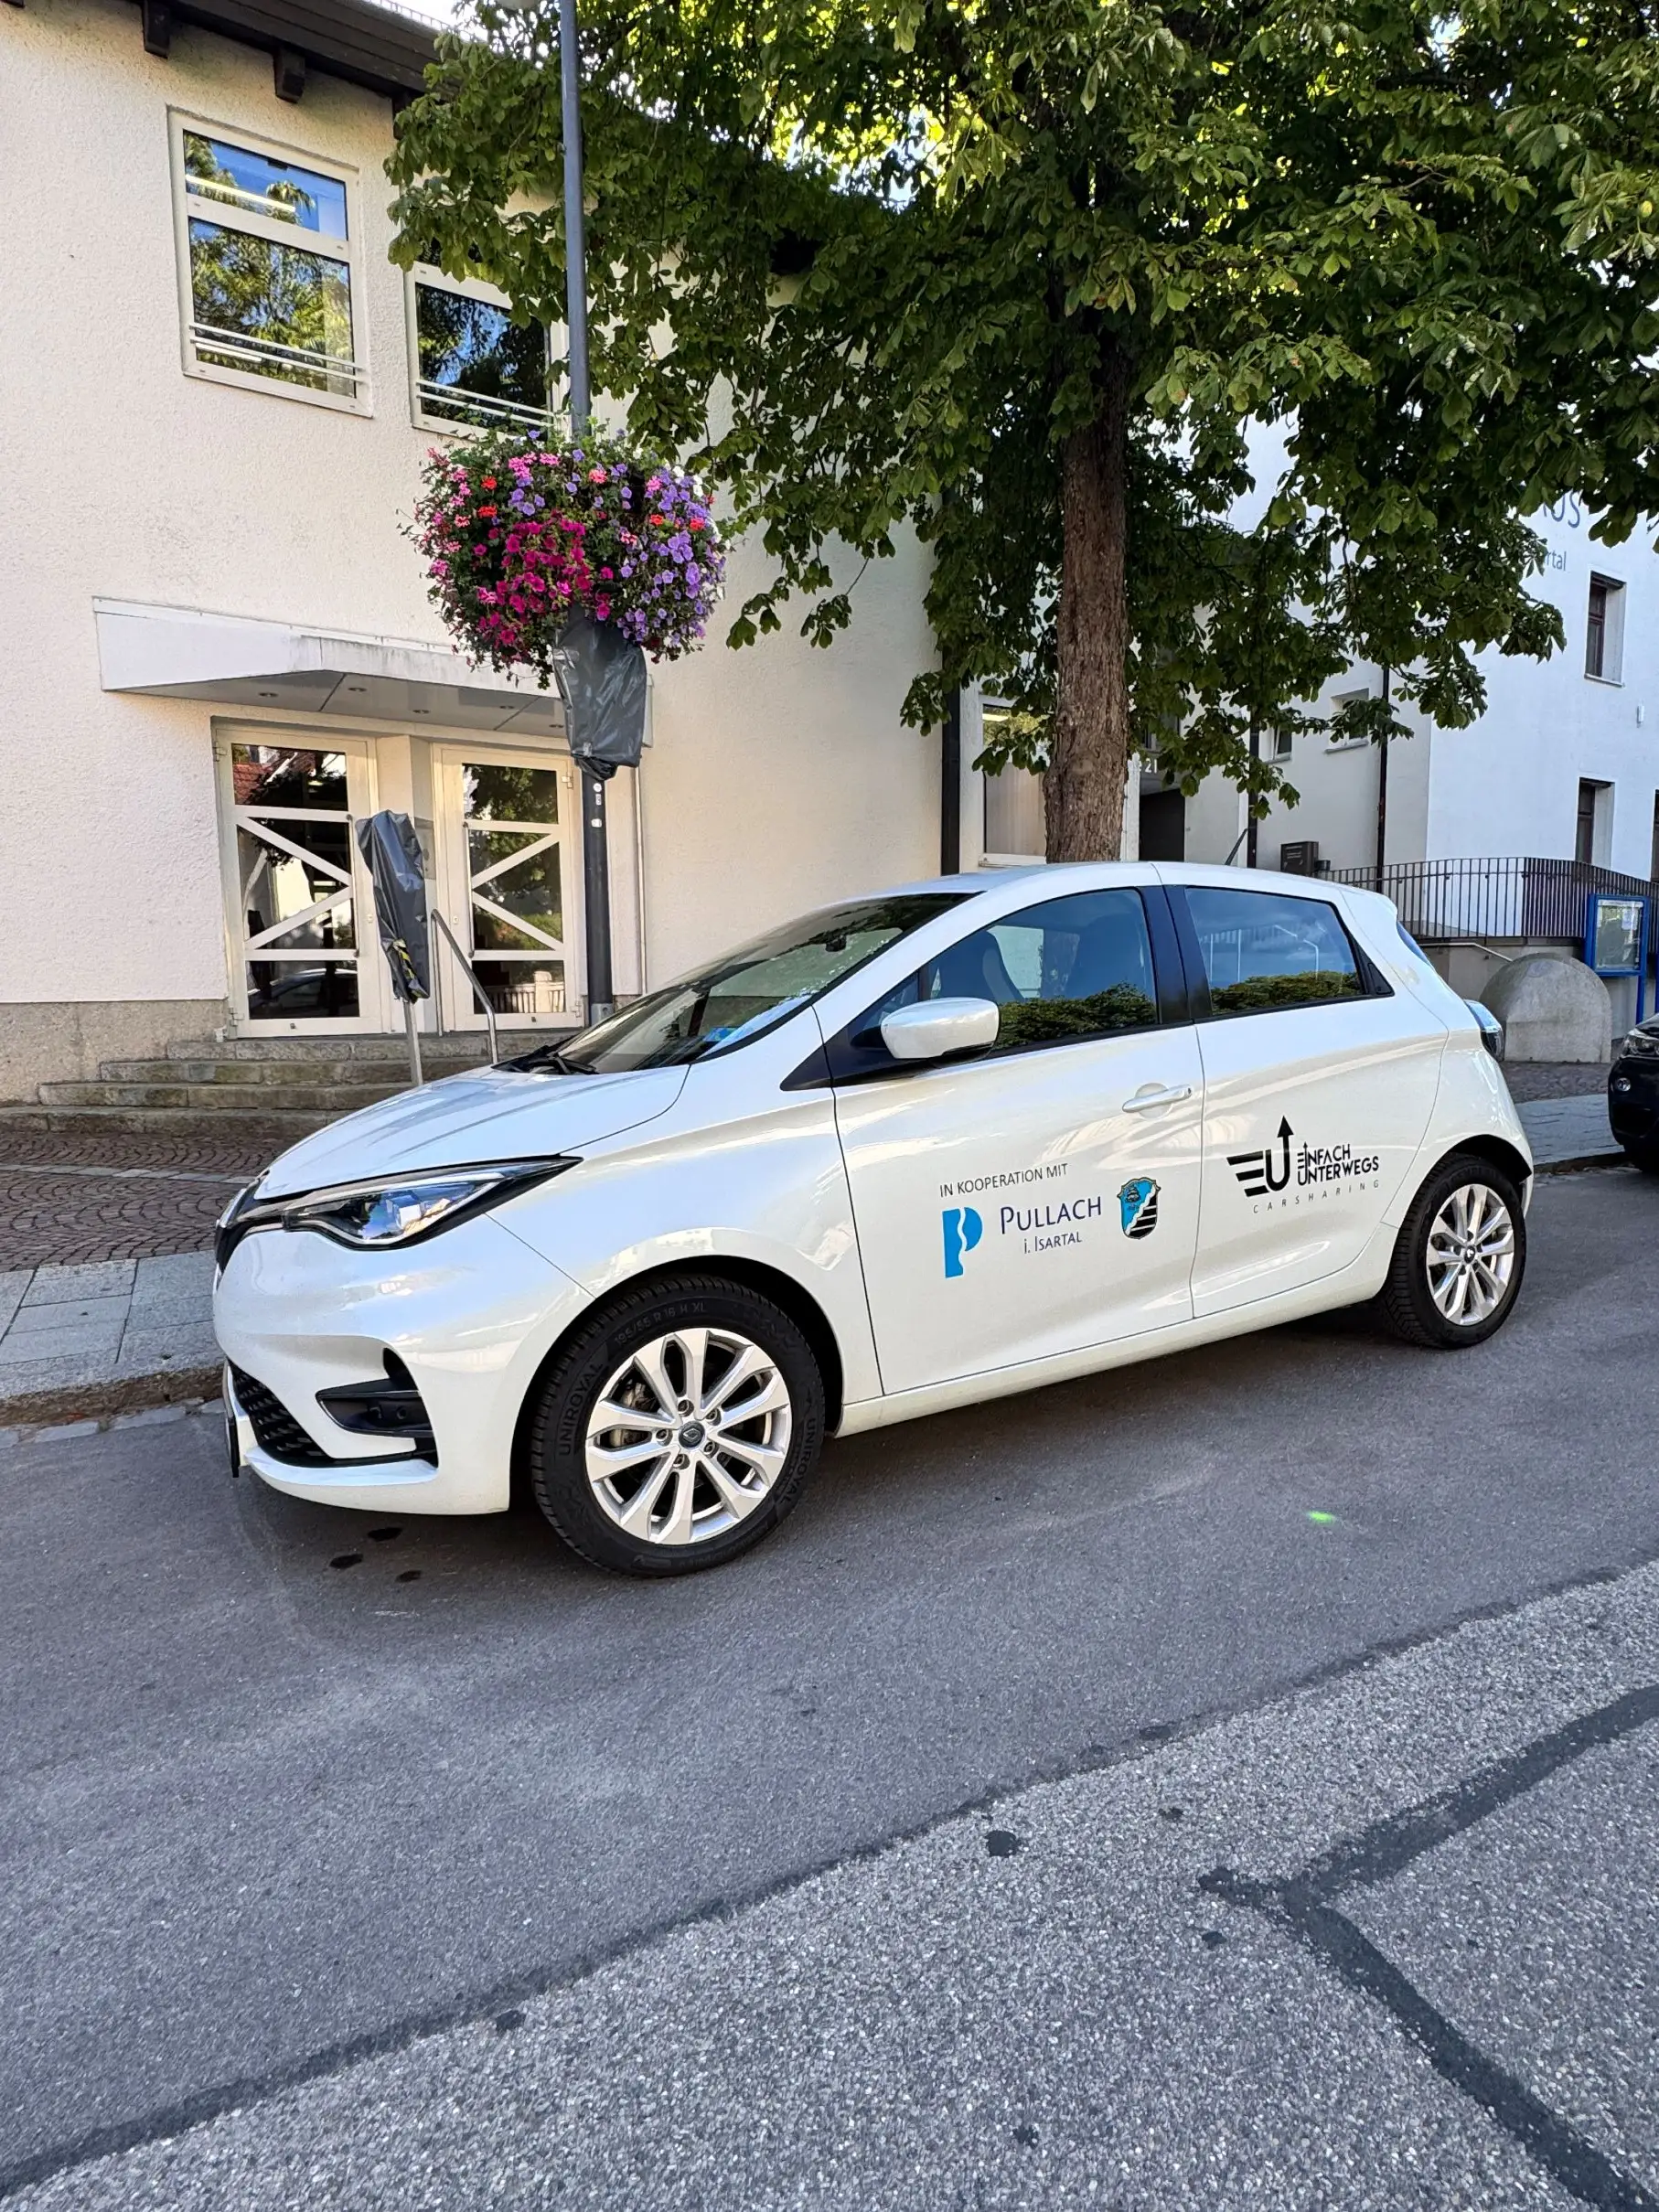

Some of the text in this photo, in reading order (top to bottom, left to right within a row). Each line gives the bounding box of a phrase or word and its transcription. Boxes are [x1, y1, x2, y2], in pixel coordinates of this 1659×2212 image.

[1297, 1141, 1351, 1171] EINFACH
[1297, 1156, 1379, 1186] UNTERWEGS
[939, 1163, 1068, 1198] IN KOOPERATION MIT
[1253, 1180, 1380, 1214] CARSHARING
[1000, 1196, 1102, 1234] PULLACH
[1034, 1232, 1083, 1252] ISARTAL
[558, 1362, 604, 1456] UNIROYAL
[780, 1417, 817, 1504] UNIROYAL
